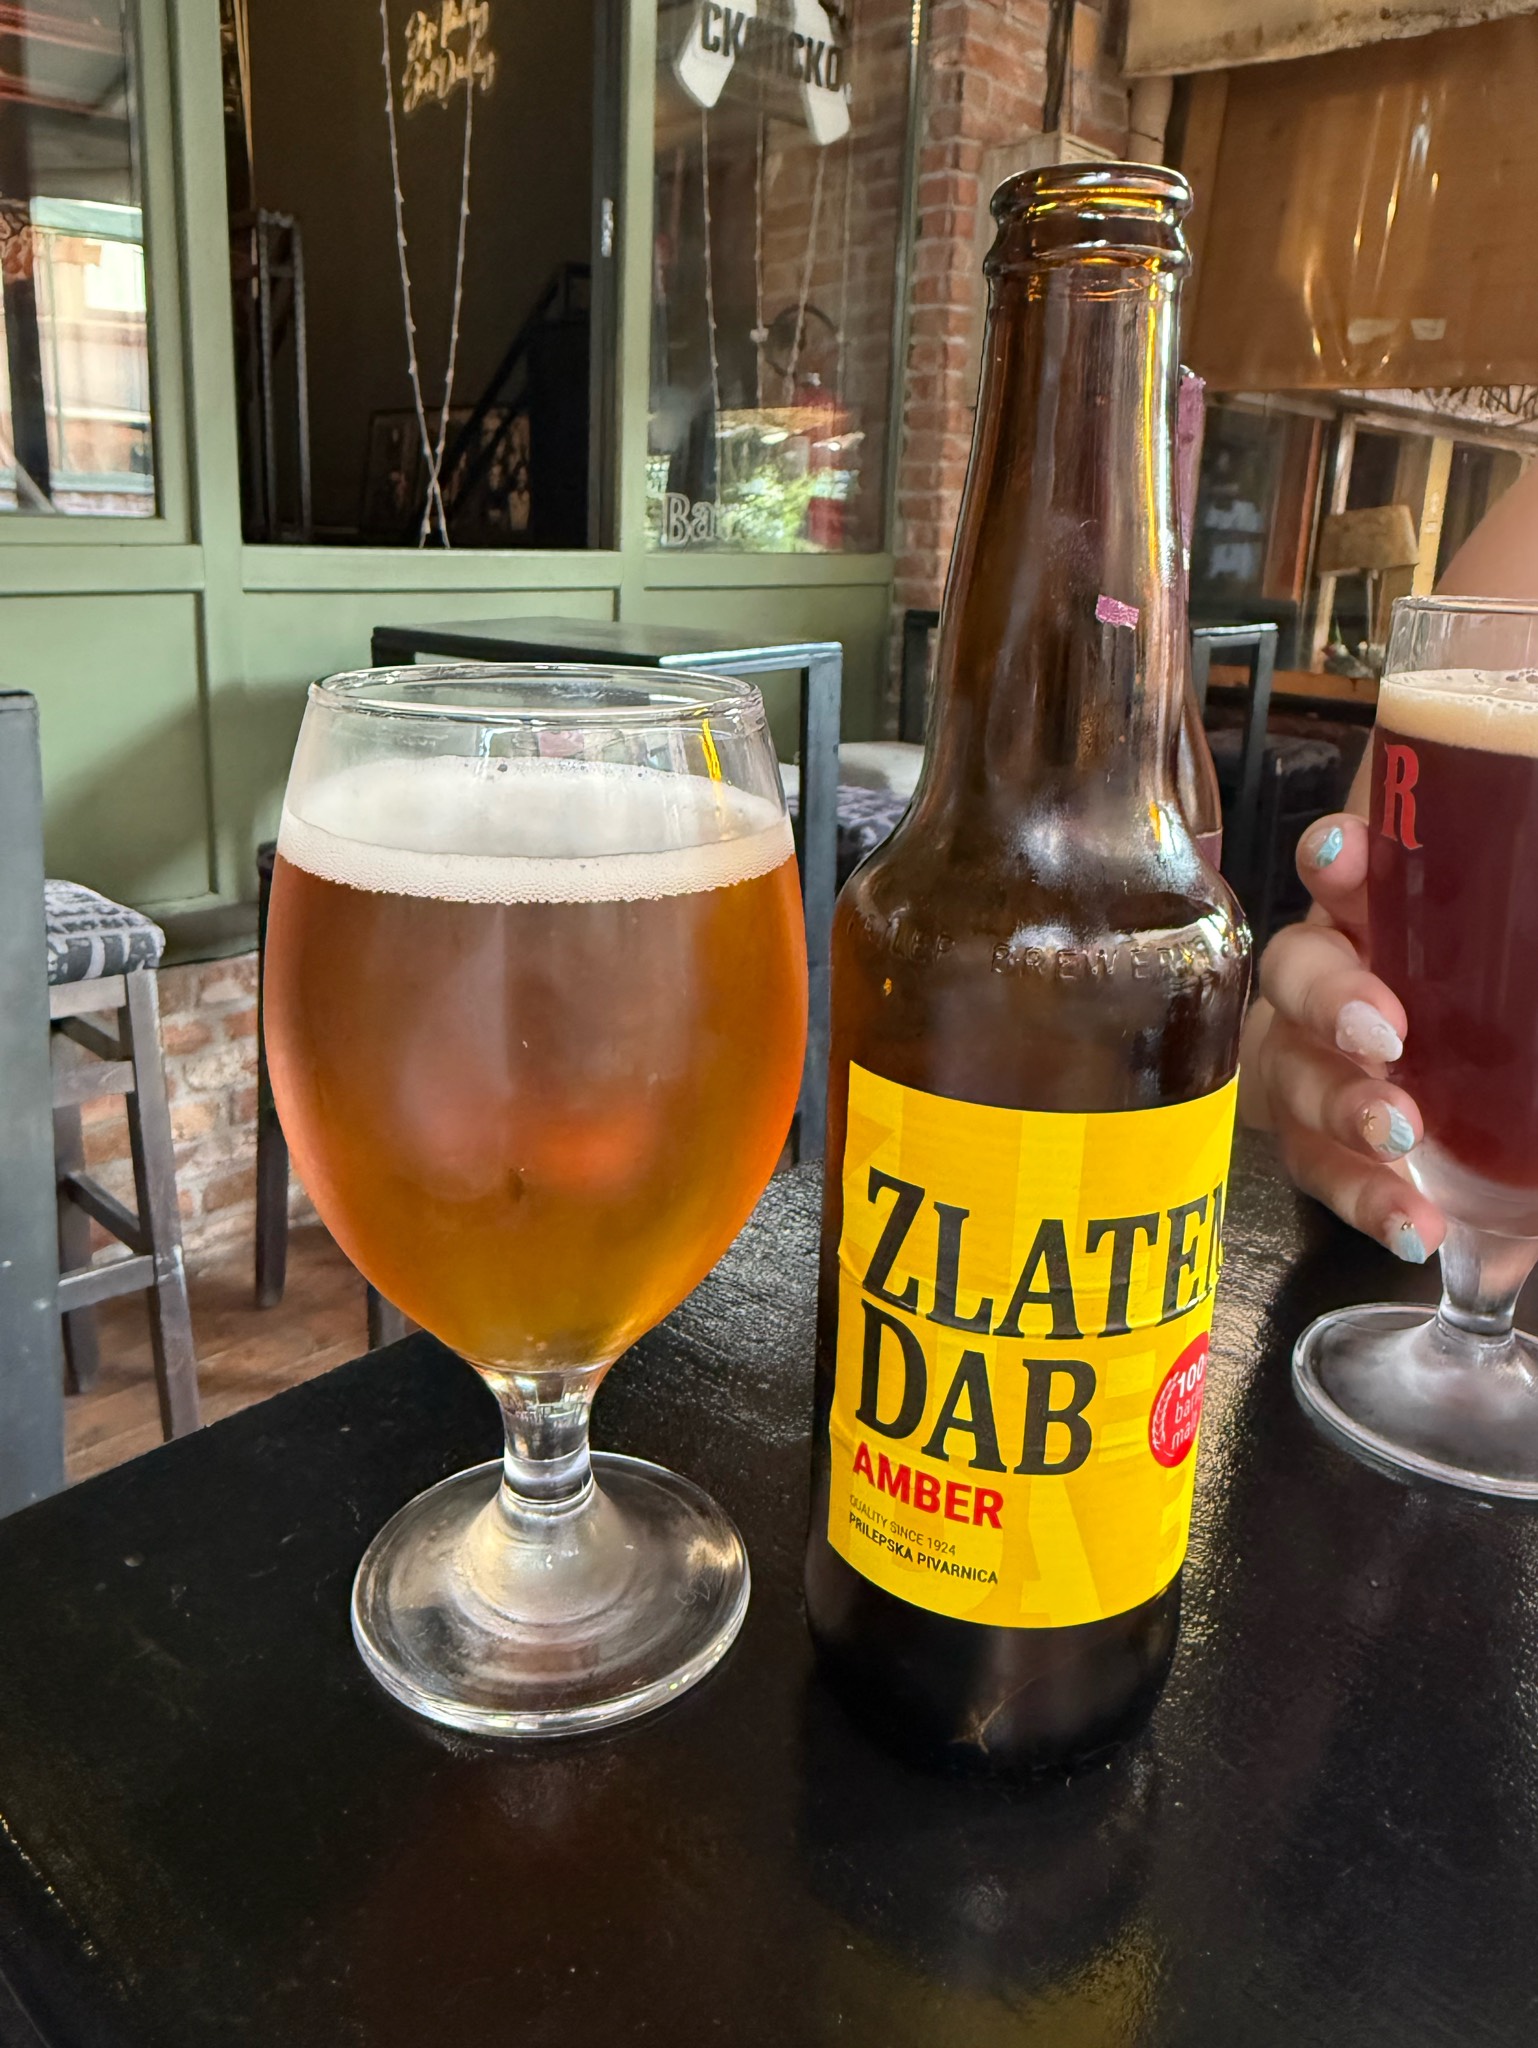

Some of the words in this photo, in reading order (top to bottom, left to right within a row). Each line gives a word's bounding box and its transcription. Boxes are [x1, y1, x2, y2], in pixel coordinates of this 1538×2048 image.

[855, 1299, 1097, 1476] DAB
[853, 1441, 1004, 1529] AMBER
[849, 1512, 914, 1563] PRILEPSKA
[917, 1552, 999, 1585] PIVARNICA
[850, 1495, 888, 1528] QUALITY
[890, 1521, 925, 1546] SINCE
[927, 1537, 956, 1556] 1924
